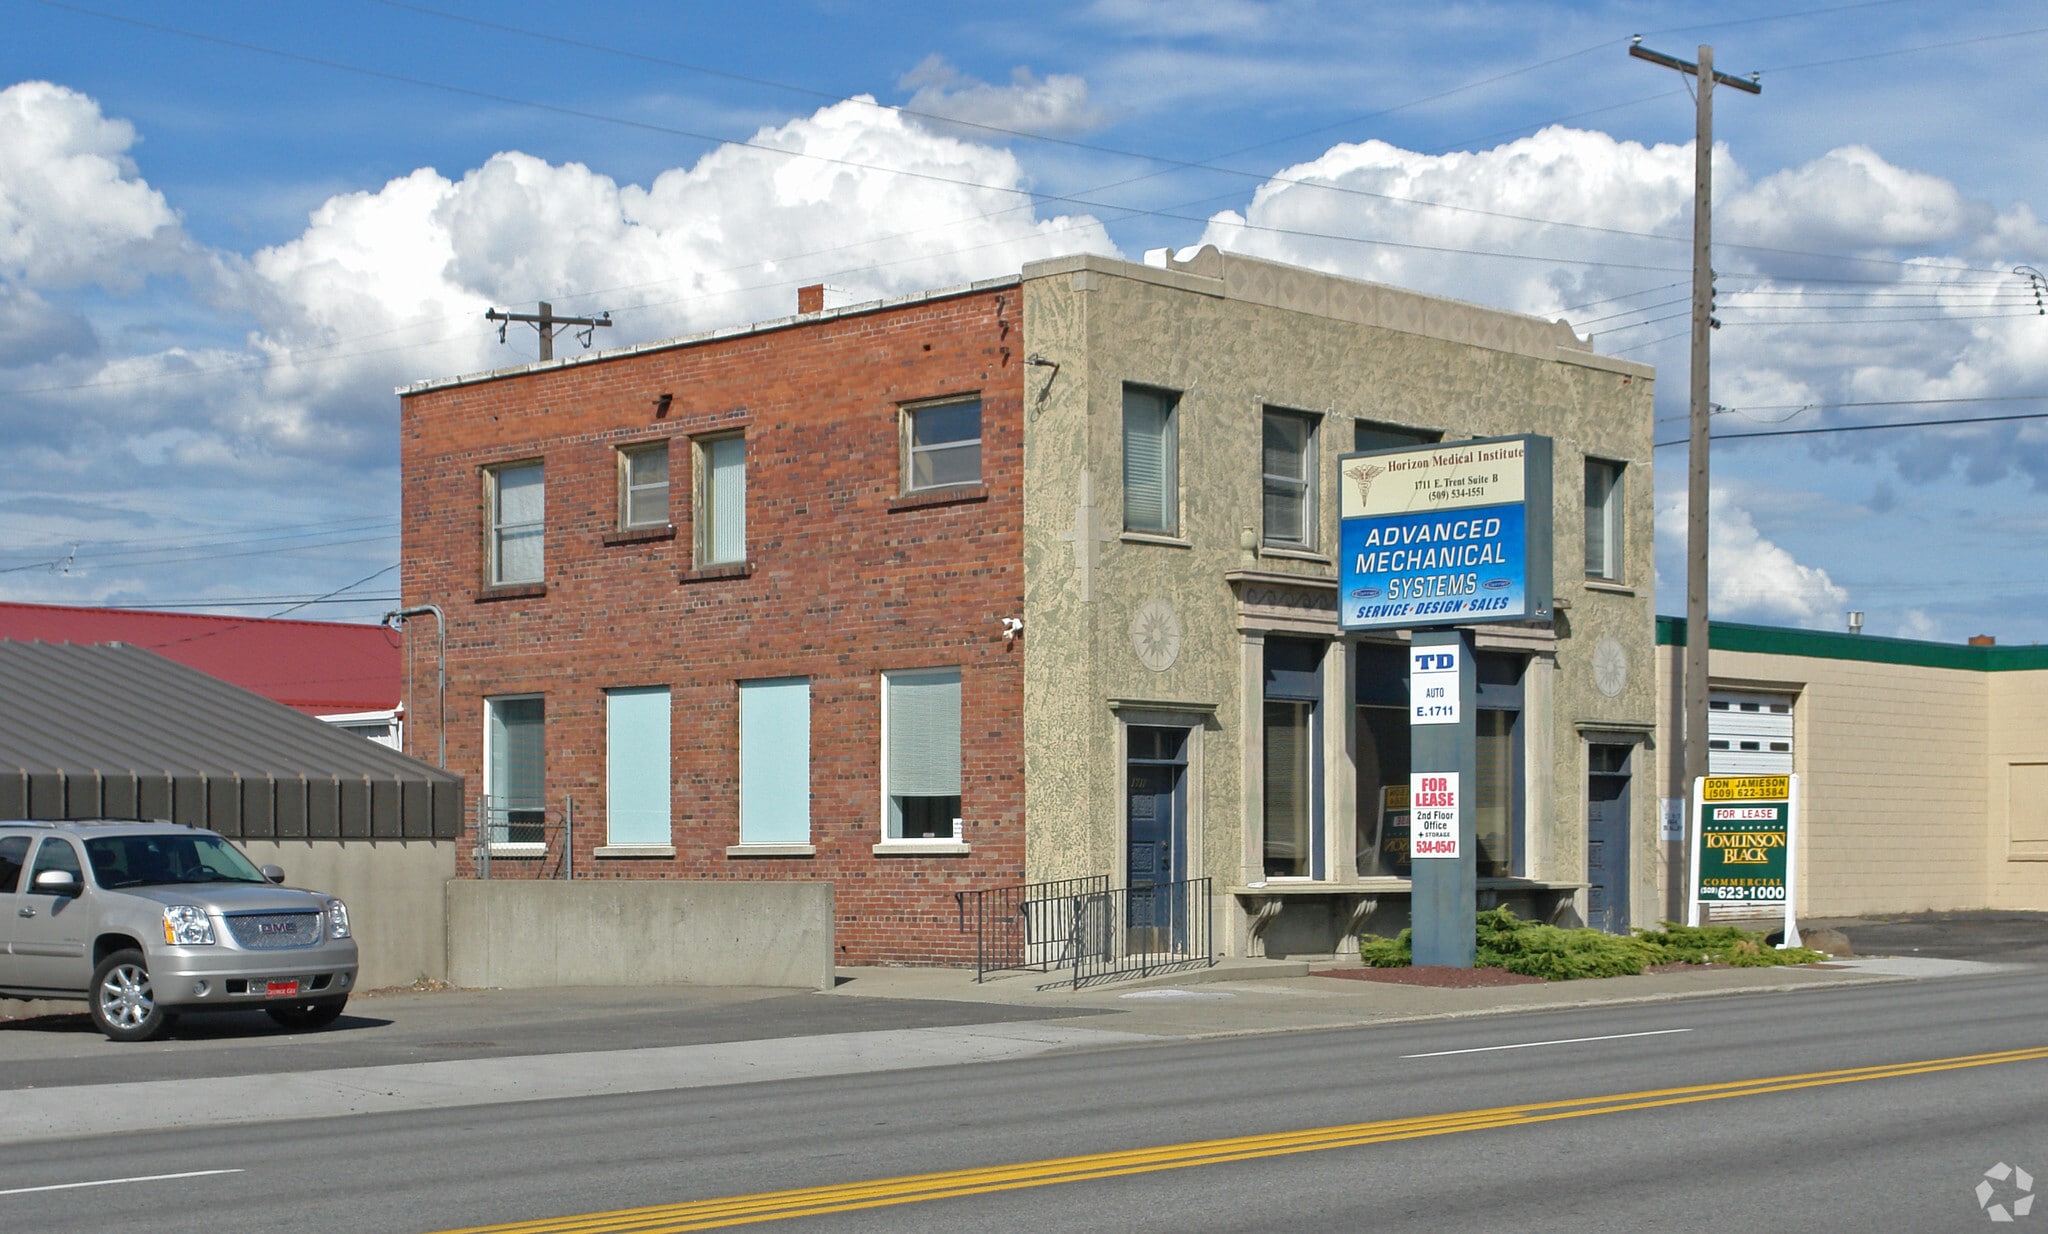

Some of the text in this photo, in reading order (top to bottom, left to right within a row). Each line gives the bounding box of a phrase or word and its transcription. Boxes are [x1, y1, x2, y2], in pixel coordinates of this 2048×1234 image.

[1388, 448, 1524, 472] Horizon Medical Institute
[1415, 474, 1499, 490] 1711 E. Trent Suite B
[1428, 487, 1484, 502] (509) 534-1551
[1365, 518, 1501, 547] ADVANCED
[1355, 542, 1506, 575] MECHANICAL
[1387, 573, 1478, 600] SYSTEMS
[1356, 597, 1509, 619] SERVICE DESIGN SALES
[1415, 653, 1454, 670] TD
[1426, 687, 1444, 698] AUTO
[1416, 705, 1453, 716] E.1711
[1422, 777, 1447, 792] FOR
[1709, 778, 1785, 789] DON JAMIESON
[1415, 792, 1454, 807] LEASE
[1709, 787, 1784, 798] (509) 622-3584
[1417, 811, 1453, 820] 2nd Floor
[1717, 809, 1773, 818] FOR LEASE
[1424, 820, 1447, 830] Office
[1416, 841, 1456, 853] 534-0547
[1703, 832, 1786, 848] TOMLINSON
[1722, 847, 1769, 864] BLACK
[1703, 878, 1782, 886] COMMERCIAL
[1718, 886, 1784, 899] 623-1000
[259, 923, 298, 934] GMC
